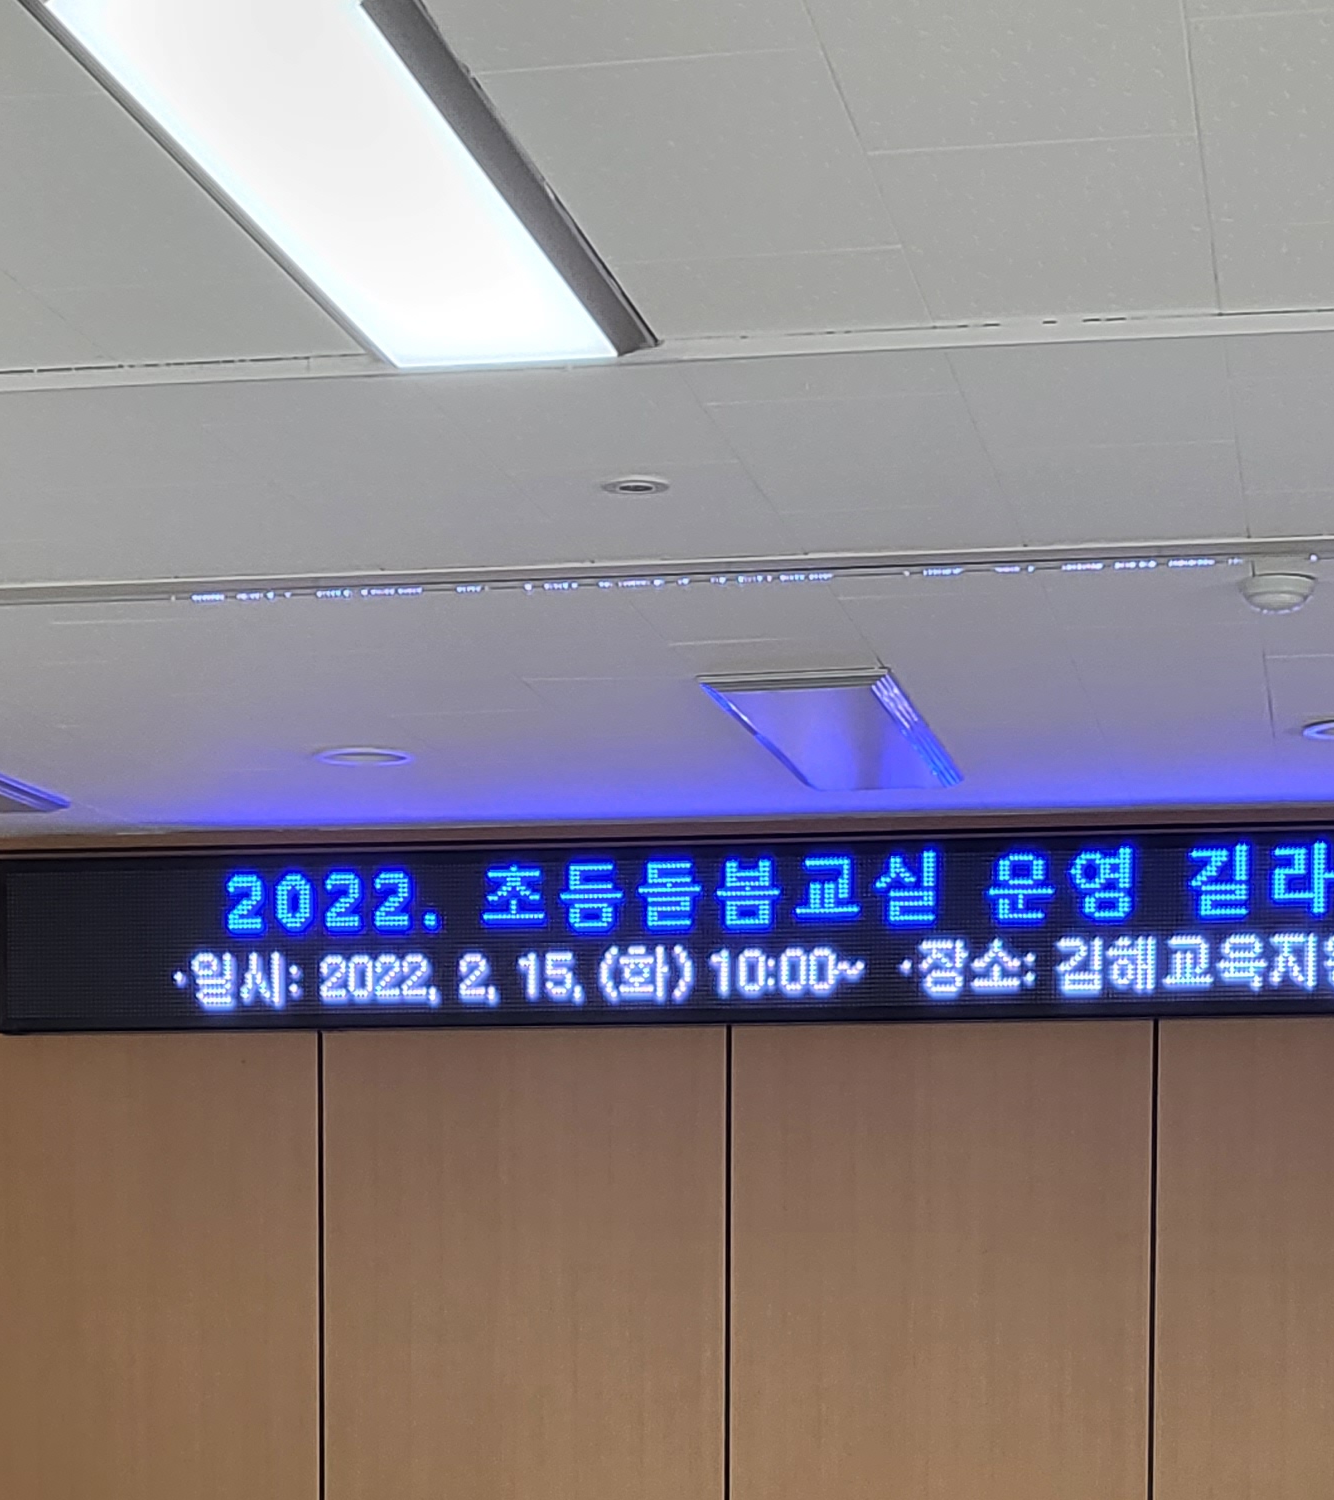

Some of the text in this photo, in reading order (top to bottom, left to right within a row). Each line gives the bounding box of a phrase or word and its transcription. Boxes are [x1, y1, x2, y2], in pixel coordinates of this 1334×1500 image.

[224, 868, 440, 934] 2022.
[480, 847, 939, 934] 초등돌봄교실
[986, 844, 1136, 924] 운영
[709, 946, 865, 1000] 10:00~
